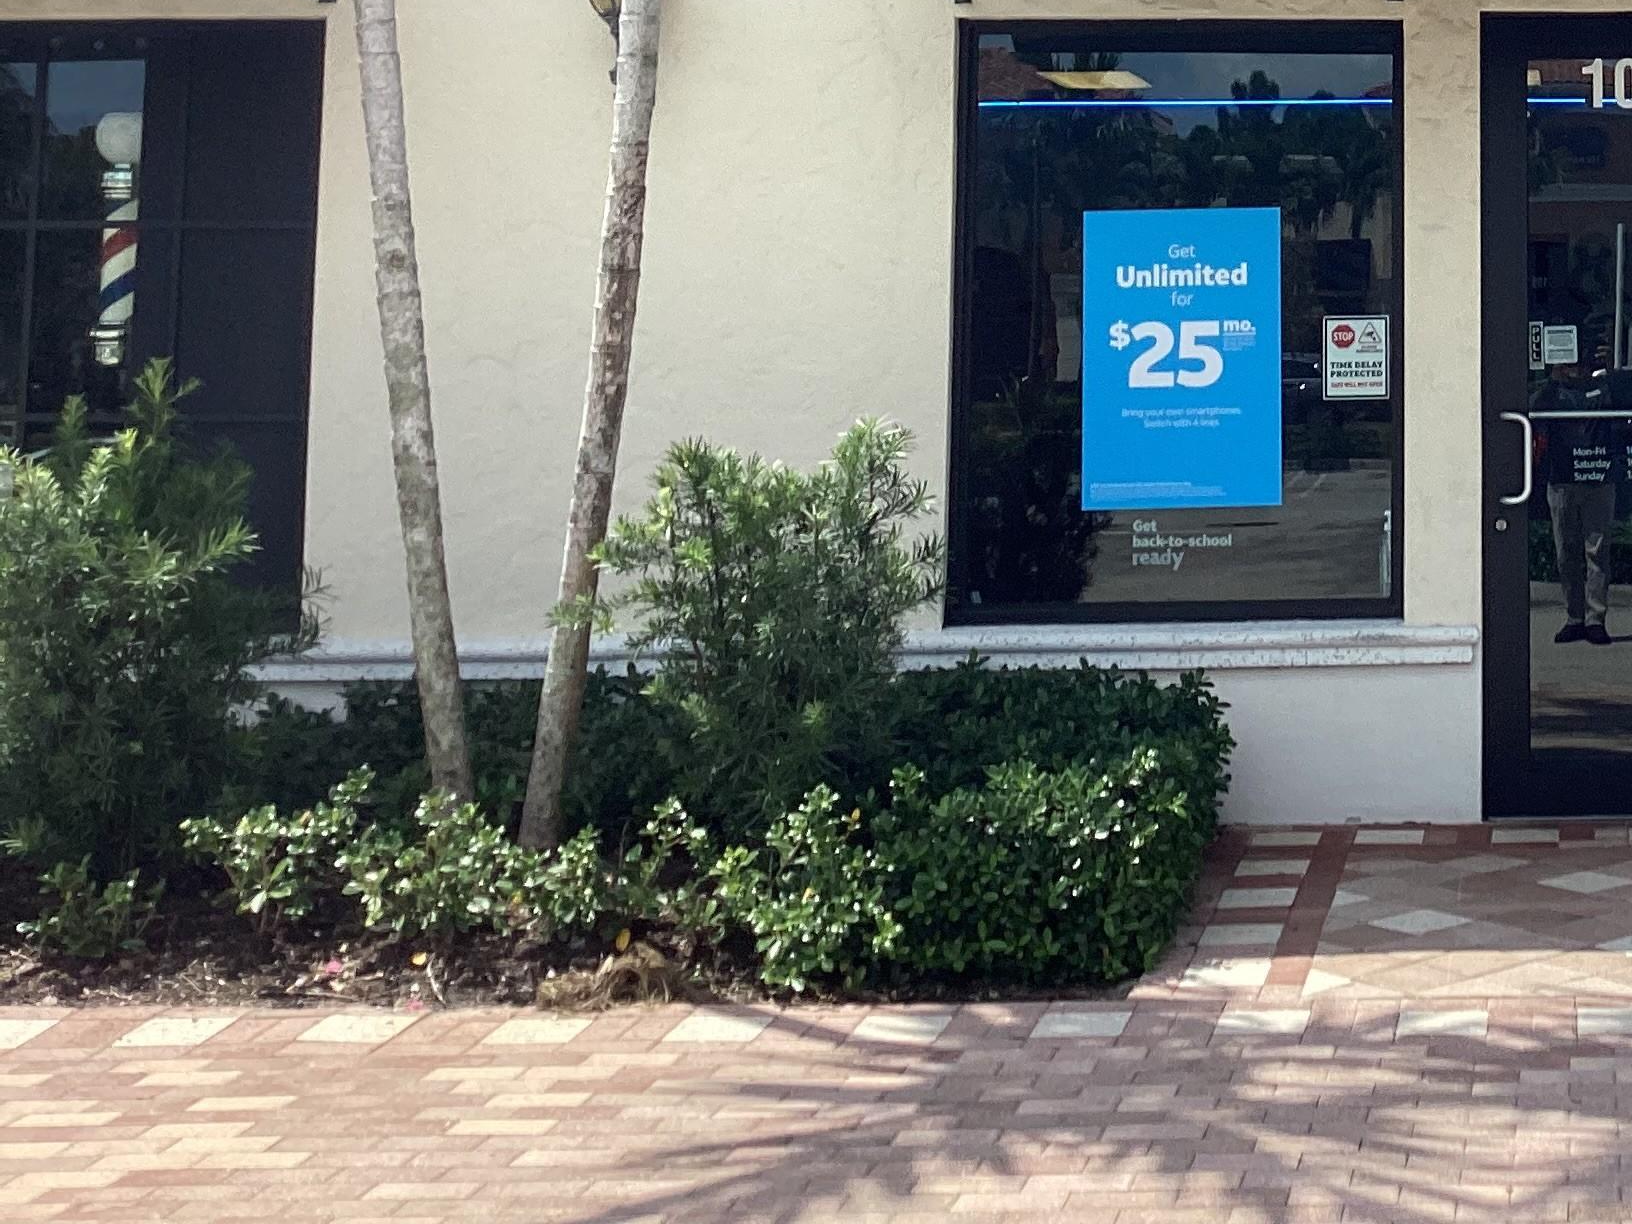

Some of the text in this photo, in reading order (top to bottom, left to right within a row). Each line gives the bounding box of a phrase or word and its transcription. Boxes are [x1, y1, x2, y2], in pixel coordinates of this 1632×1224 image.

[1168, 244, 1197, 258] Get
[1116, 262, 1249, 288] Unlimited
[1171, 290, 1194, 306] for
[1223, 320, 1256, 332] mo.
[1333, 331, 1354, 342] STOP
[1532, 327, 1540, 360] PULL
[1354, 361, 1383, 369] DELAY
[1330, 370, 1383, 378] PROTECTED
[1573, 459, 1611, 470] Saturday
[1574, 471, 1605, 481] Sunday
[1132, 519, 1157, 532] Get
[1131, 534, 1233, 548] back-to-school
[1131, 548, 1185, 571] ready
